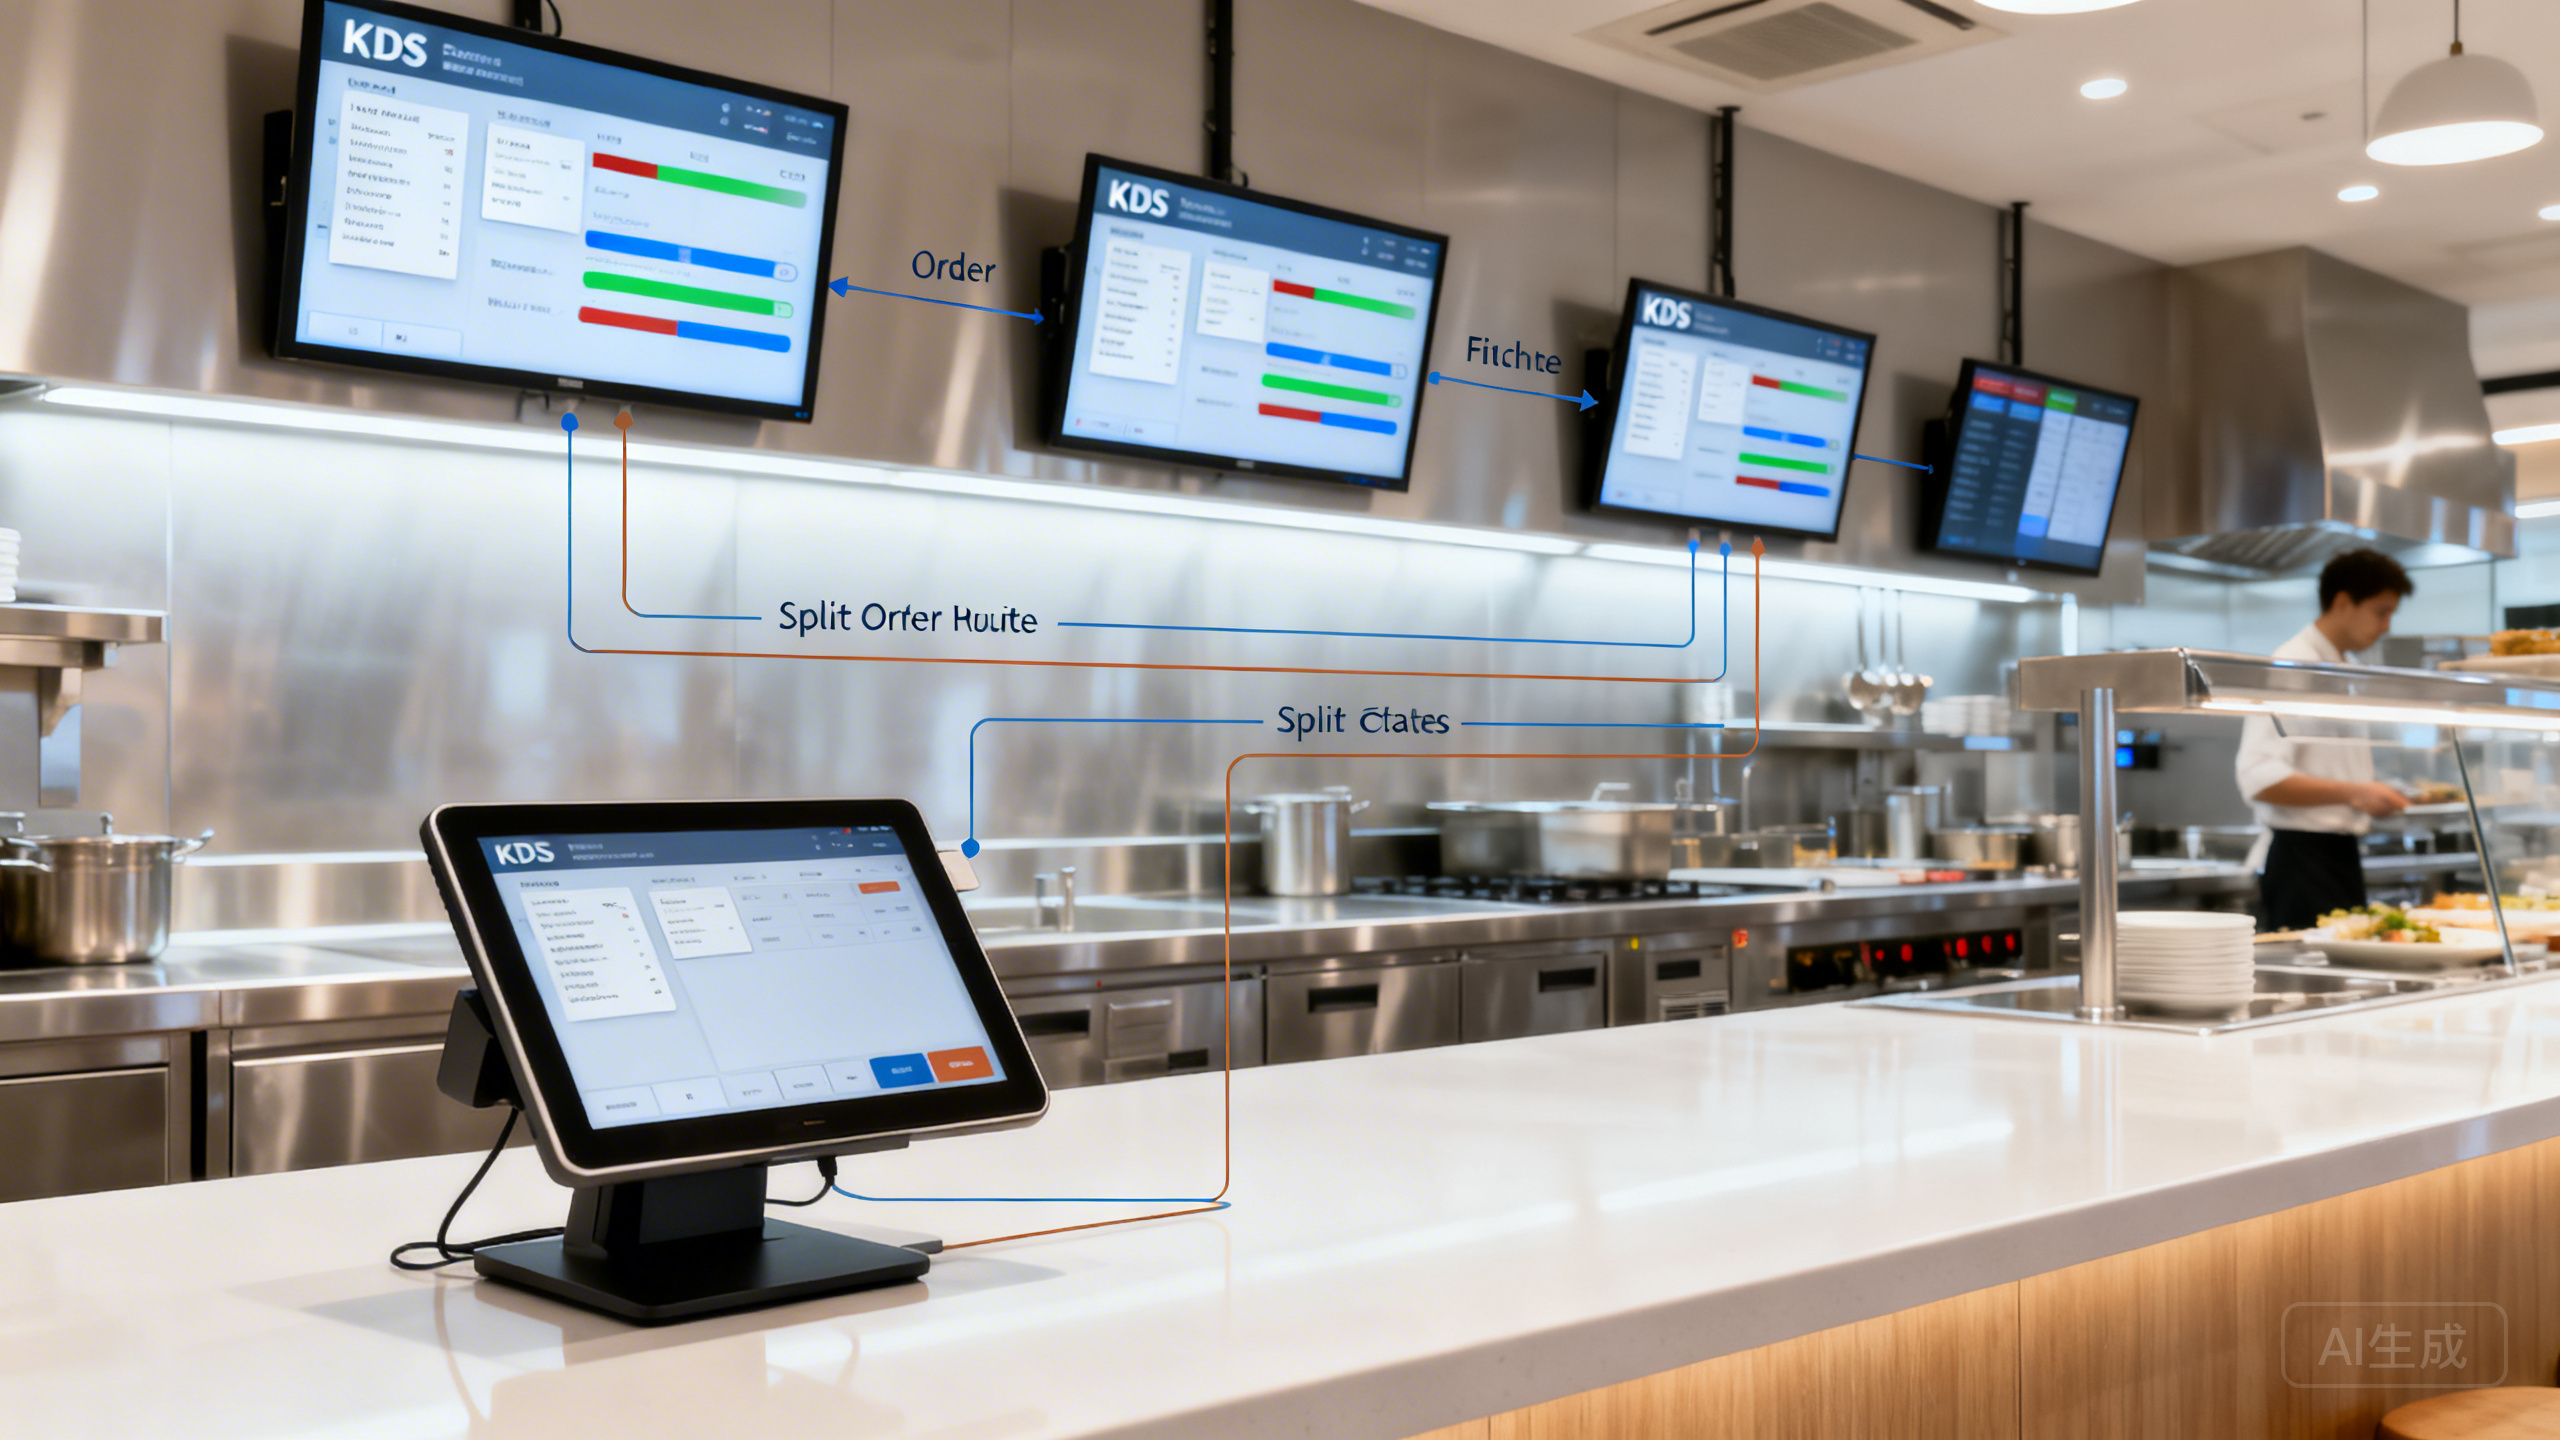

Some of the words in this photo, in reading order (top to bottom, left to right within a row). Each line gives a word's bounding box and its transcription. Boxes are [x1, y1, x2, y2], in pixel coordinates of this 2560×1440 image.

[342, 19, 428, 68] KDS
[1108, 179, 1170, 218] KDS
[1642, 294, 1693, 330] KDS
[494, 842, 555, 866] KDS
